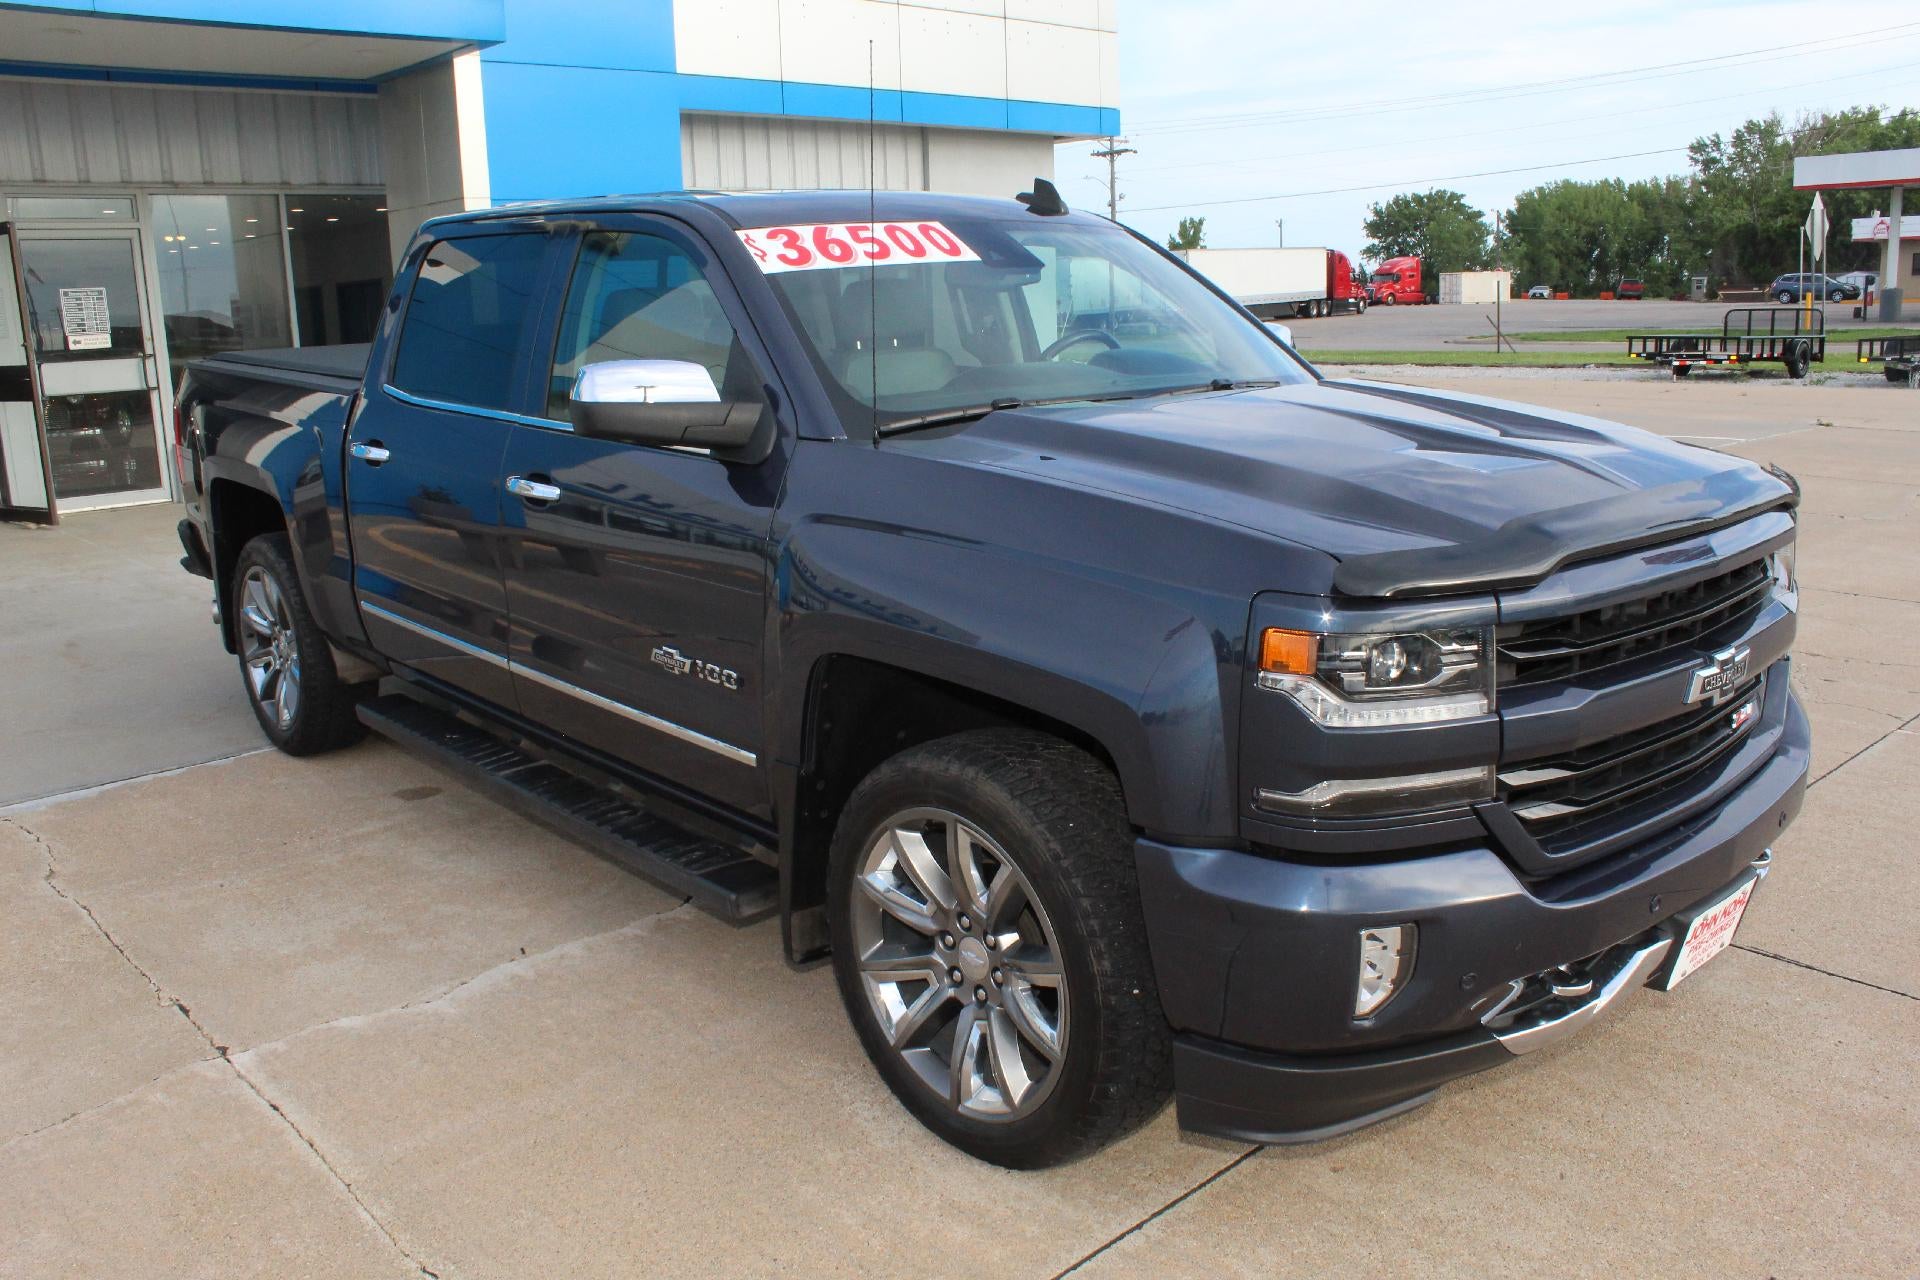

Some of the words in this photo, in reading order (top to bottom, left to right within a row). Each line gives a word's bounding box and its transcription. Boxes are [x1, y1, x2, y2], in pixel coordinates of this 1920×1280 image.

[743, 224, 962, 267] $36500
[695, 659, 737, 691] 100
[1685, 913, 1719, 946] JOHN
